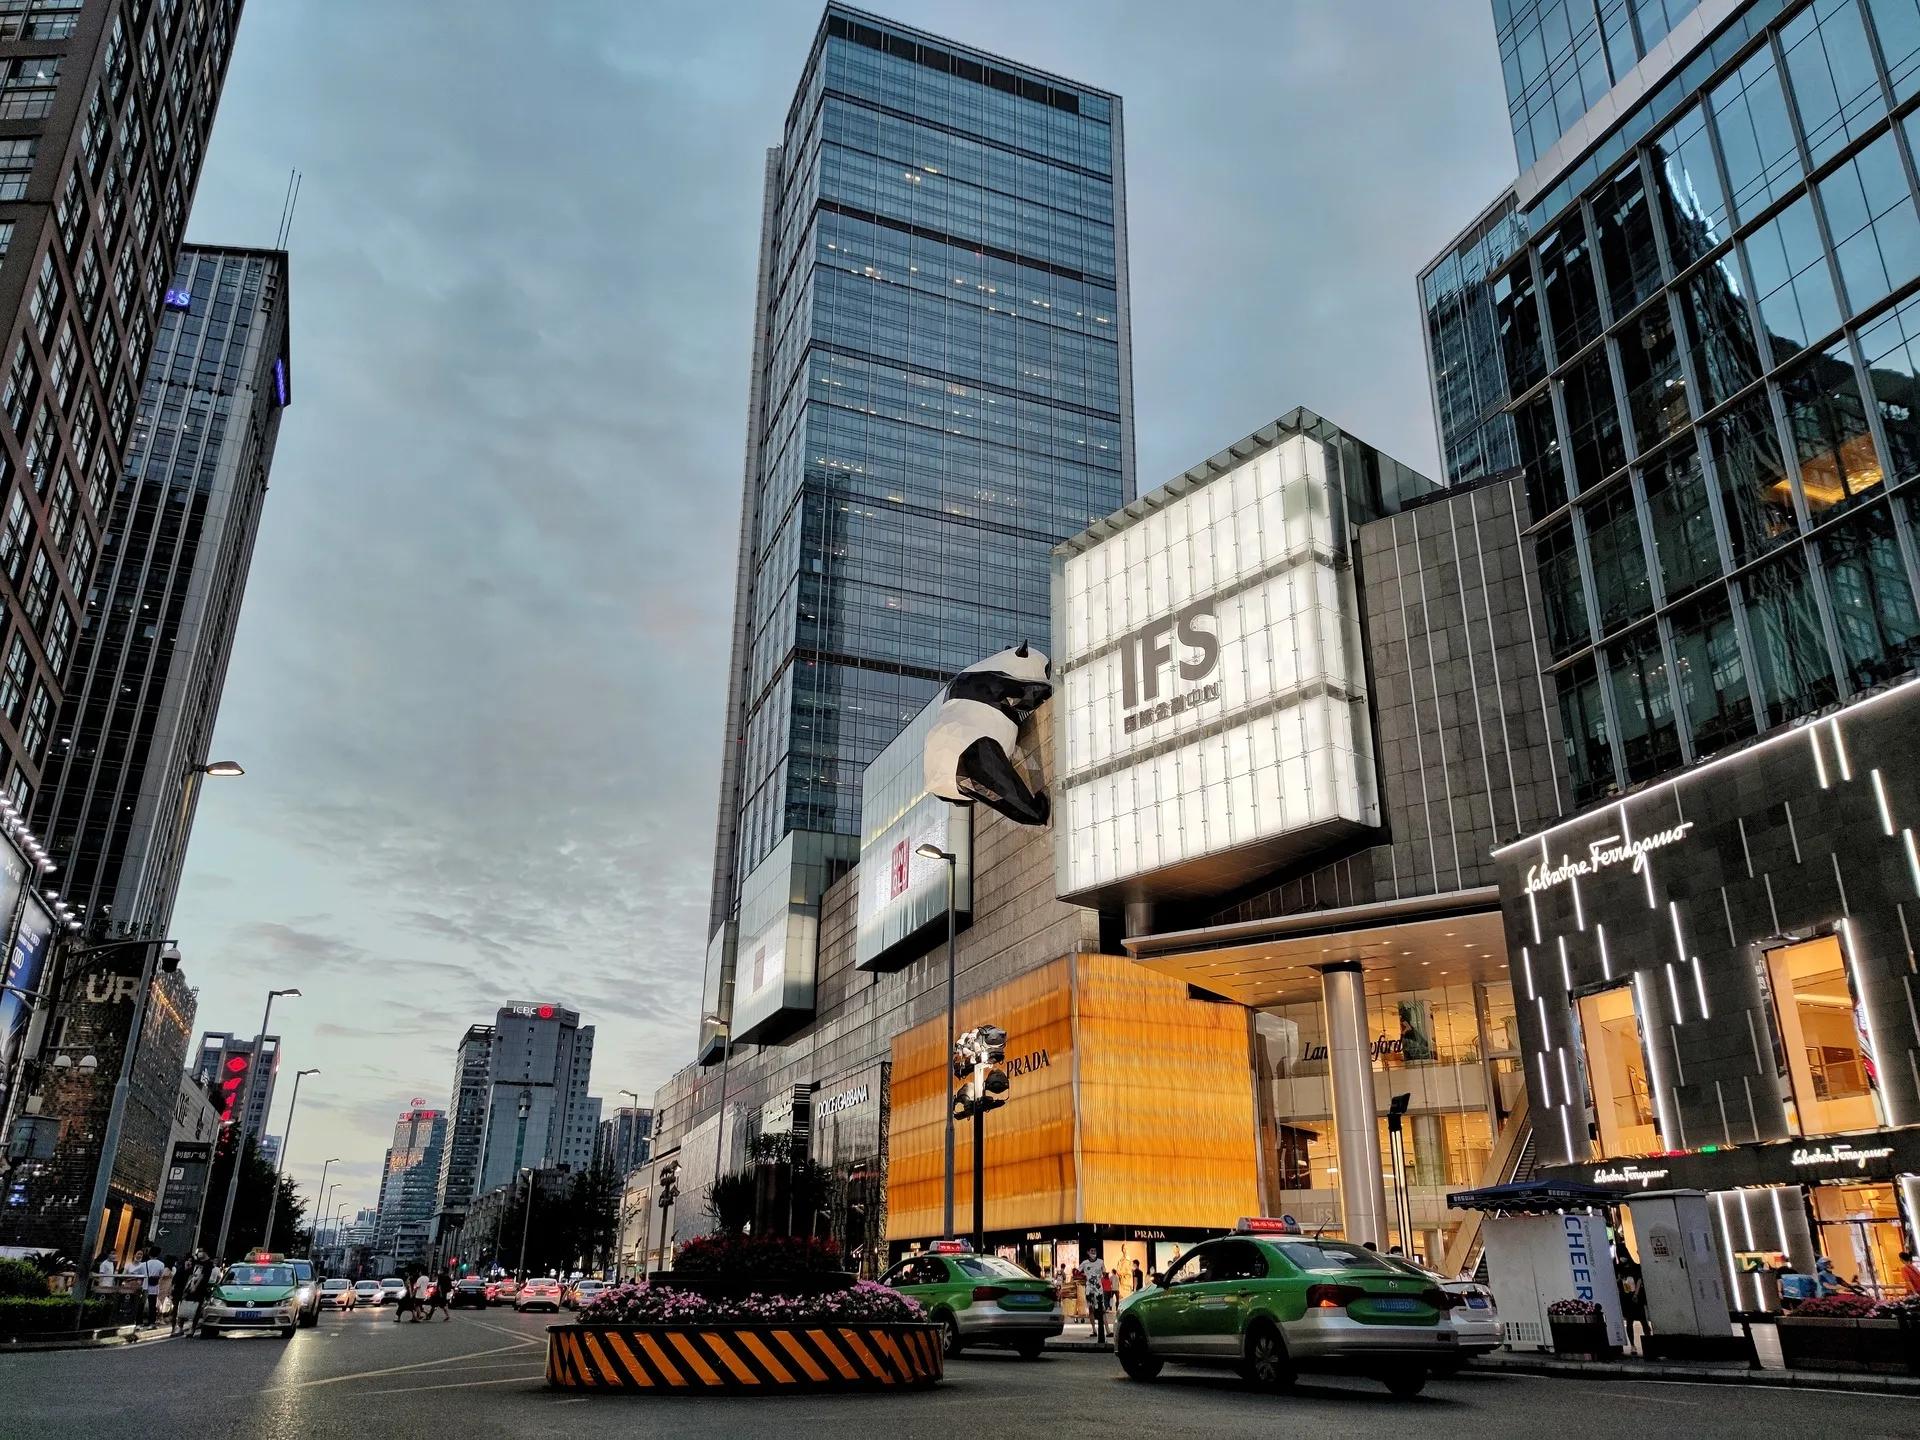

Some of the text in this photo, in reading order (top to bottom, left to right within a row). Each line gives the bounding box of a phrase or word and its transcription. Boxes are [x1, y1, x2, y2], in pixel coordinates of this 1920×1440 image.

[1120, 599, 1222, 711] IFS
[1524, 821, 1694, 894] Salvatore Ferragamo
[86, 971, 140, 1003] UR
[513, 1005, 537, 1015] ICBC
[1005, 1048, 1050, 1079] PRADA
[1302, 1041, 1329, 1062] Lan
[1790, 1144, 1895, 1169] Salvatore Ferragamo
[1313, 1207, 1333, 1223] IFS
[1134, 1230, 1166, 1240] PRADA
[1564, 1216, 1594, 1303] CHEER
